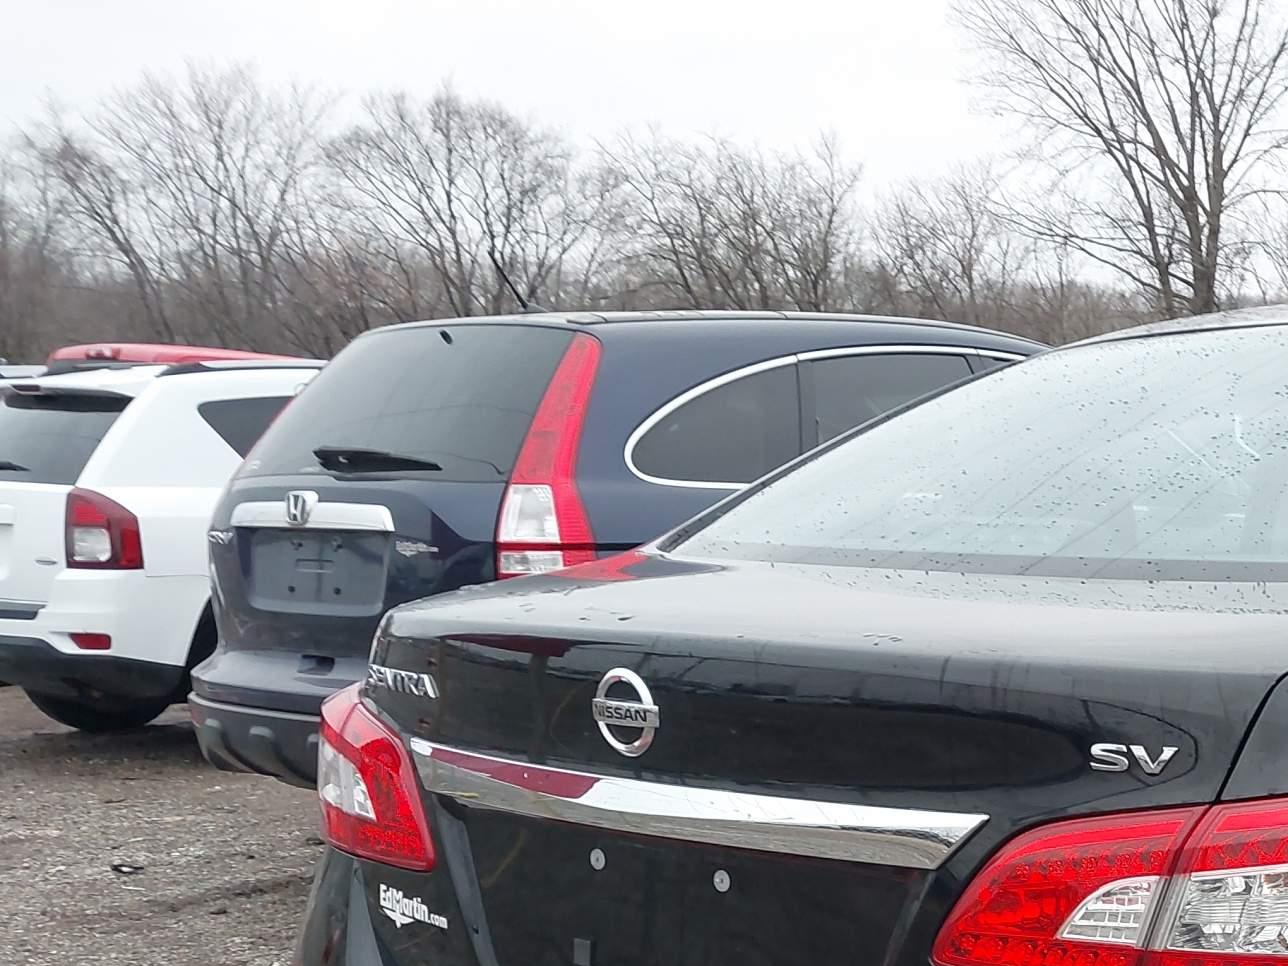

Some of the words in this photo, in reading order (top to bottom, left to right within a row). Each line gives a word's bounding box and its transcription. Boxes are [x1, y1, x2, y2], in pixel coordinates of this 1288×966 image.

[594, 703, 648, 722] NISSAN
[1089, 743, 1179, 774] SV
[379, 883, 448, 930] EdMartin.com
